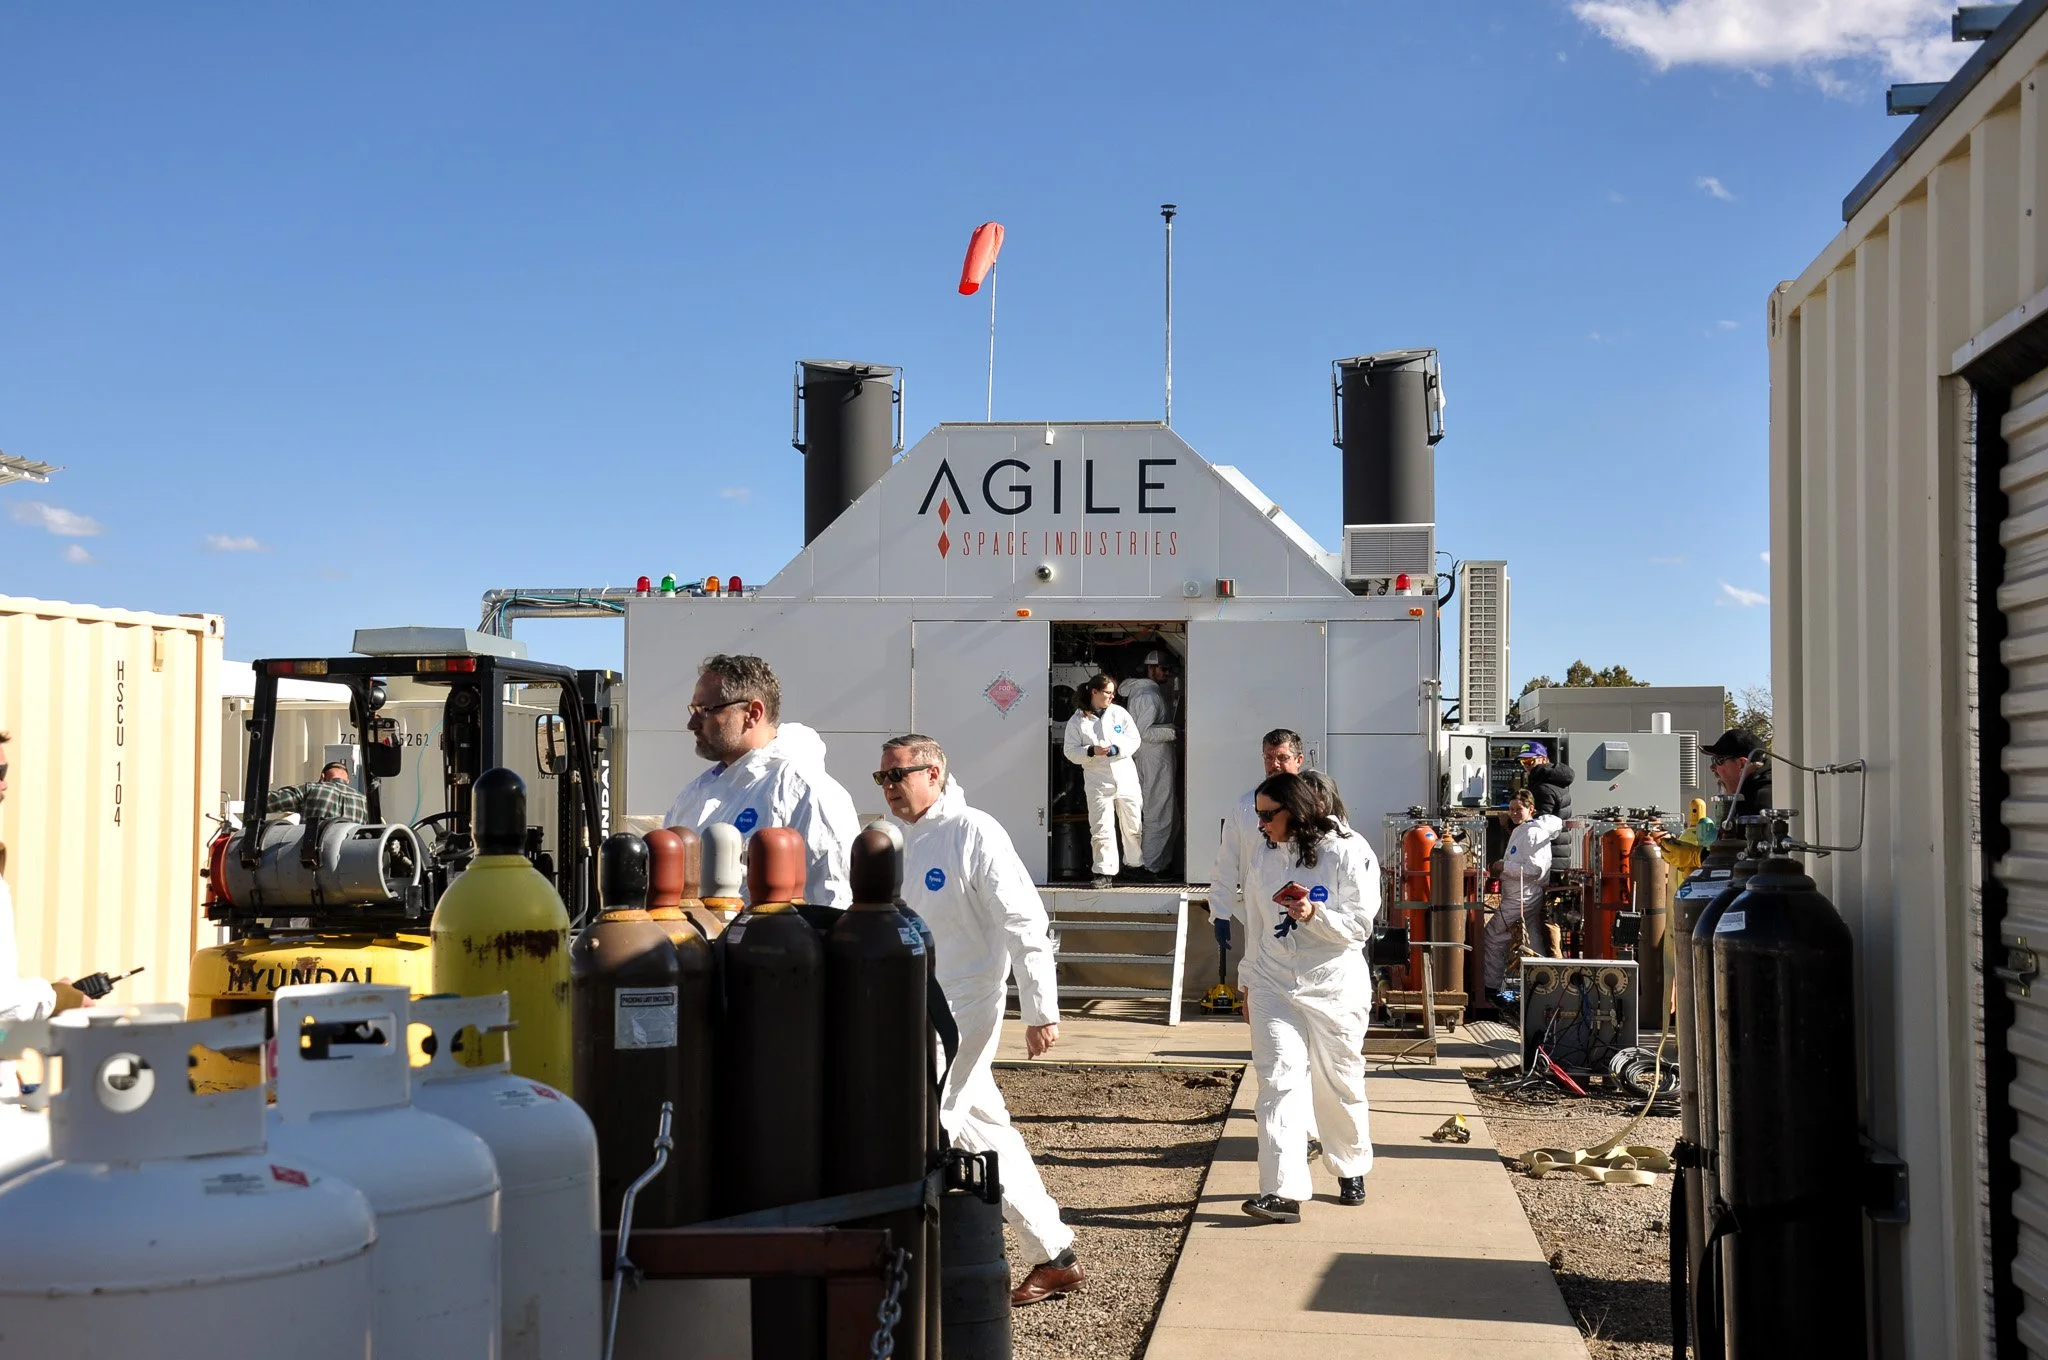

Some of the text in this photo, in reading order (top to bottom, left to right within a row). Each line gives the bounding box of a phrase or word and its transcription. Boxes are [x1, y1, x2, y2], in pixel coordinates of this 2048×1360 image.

[917, 457, 1177, 515] AGILE
[963, 531, 1177, 556] SPACE INDUSTRIES
[114, 660, 125, 827] HSCU 104
[601, 759, 610, 840] UNDAI
[227, 967, 372, 992] HYUNDAI
